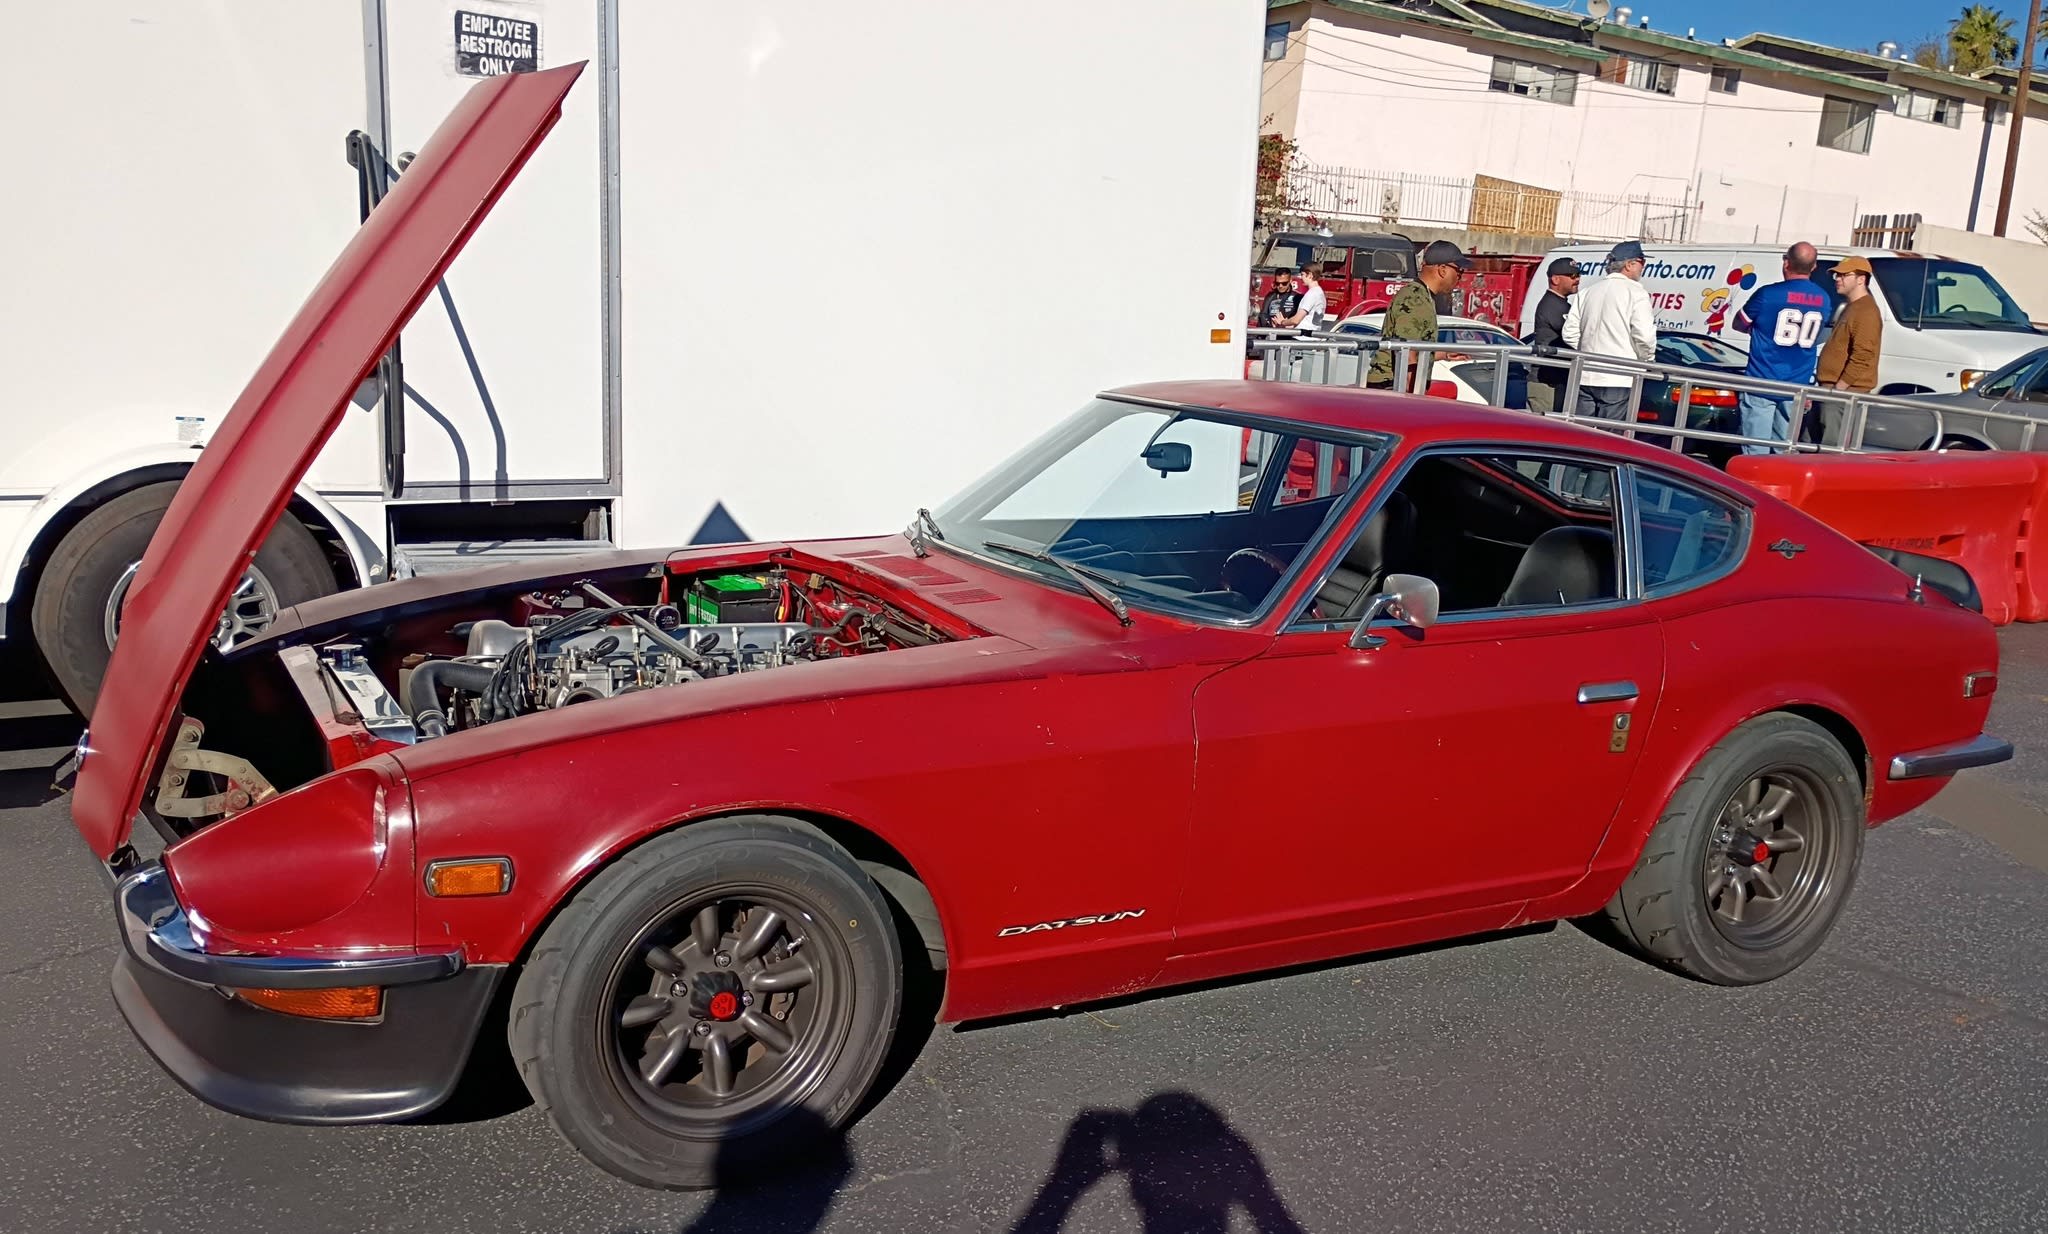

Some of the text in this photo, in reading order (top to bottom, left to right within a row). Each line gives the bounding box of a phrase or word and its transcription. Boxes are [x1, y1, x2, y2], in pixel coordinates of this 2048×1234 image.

[461, 13, 532, 41] EMPLOYEE
[460, 34, 533, 59] RESTROOM
[479, 56, 515, 76] ONLY
[1648, 292, 1686, 311] TIES
[1773, 307, 1823, 349] 60
[998, 908, 1146, 937] DATSUN
